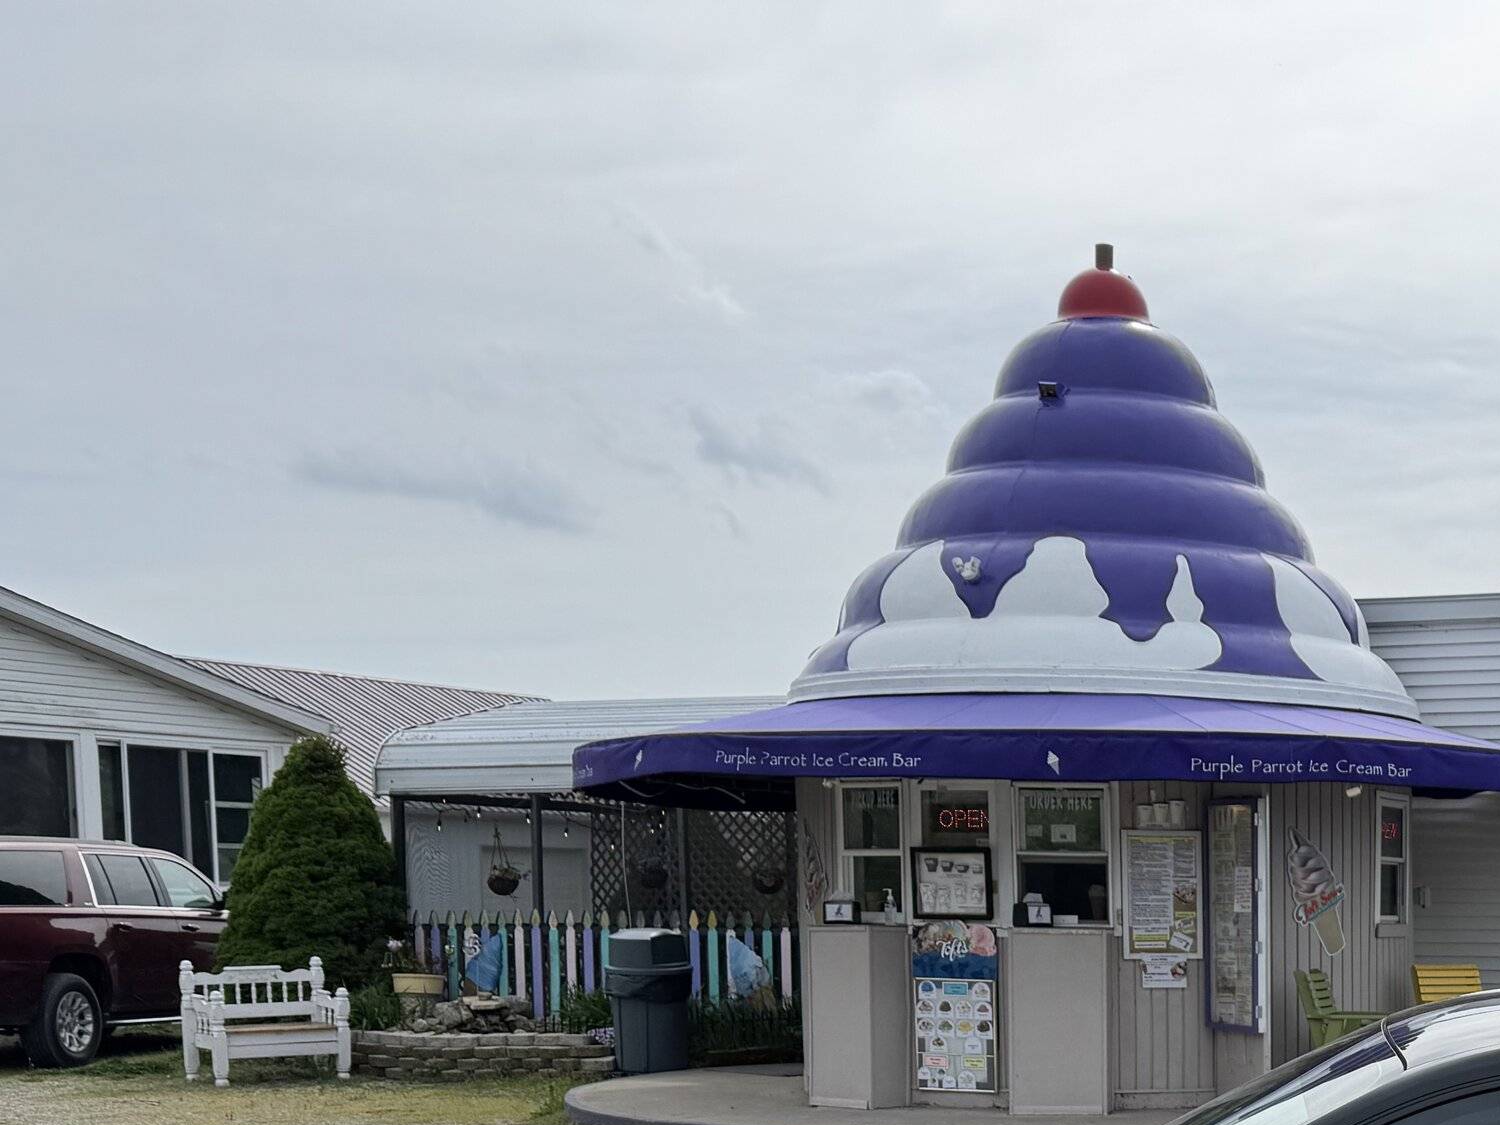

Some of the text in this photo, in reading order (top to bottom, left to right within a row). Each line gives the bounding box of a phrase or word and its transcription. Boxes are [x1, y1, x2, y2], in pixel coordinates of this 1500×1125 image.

[715, 747, 921, 771] Purple Parrot Ice Cream Bar
[1190, 755, 1412, 780] Purple Parrot Ice Cream Bar
[1067, 793, 1093, 811] HERE
[939, 809, 990, 828] OPEN
